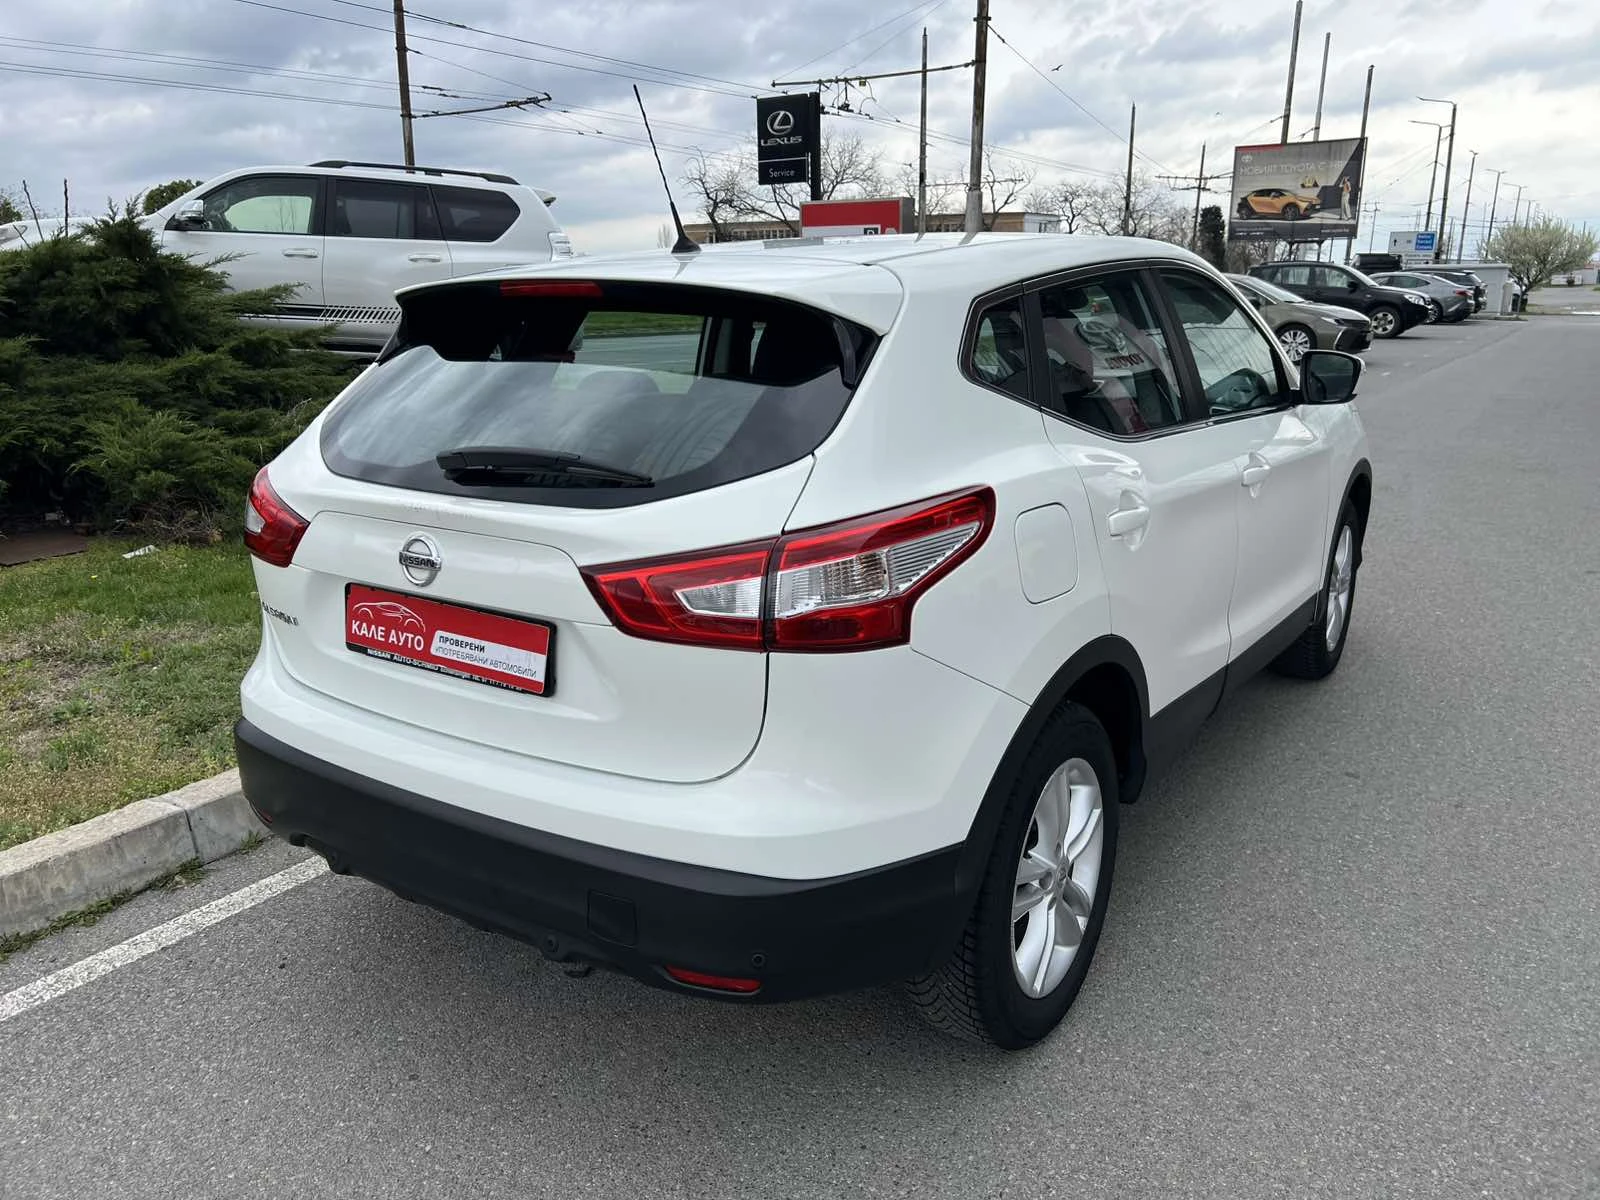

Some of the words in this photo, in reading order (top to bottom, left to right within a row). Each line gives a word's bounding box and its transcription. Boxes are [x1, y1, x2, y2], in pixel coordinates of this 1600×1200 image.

[760, 135, 802, 146] LEXUS
[769, 168, 796, 178] Service
[400, 552, 436, 568] NISSAN
[351, 620, 385, 642] КАЛЕ
[388, 629, 424, 651] АУТО
[439, 635, 485, 654] ПРОВЕРЕНИ
[435, 646, 488, 665] УПОТРЕБЯВАНИ
[489, 658, 537, 678] АВТОМОБИЛИ
